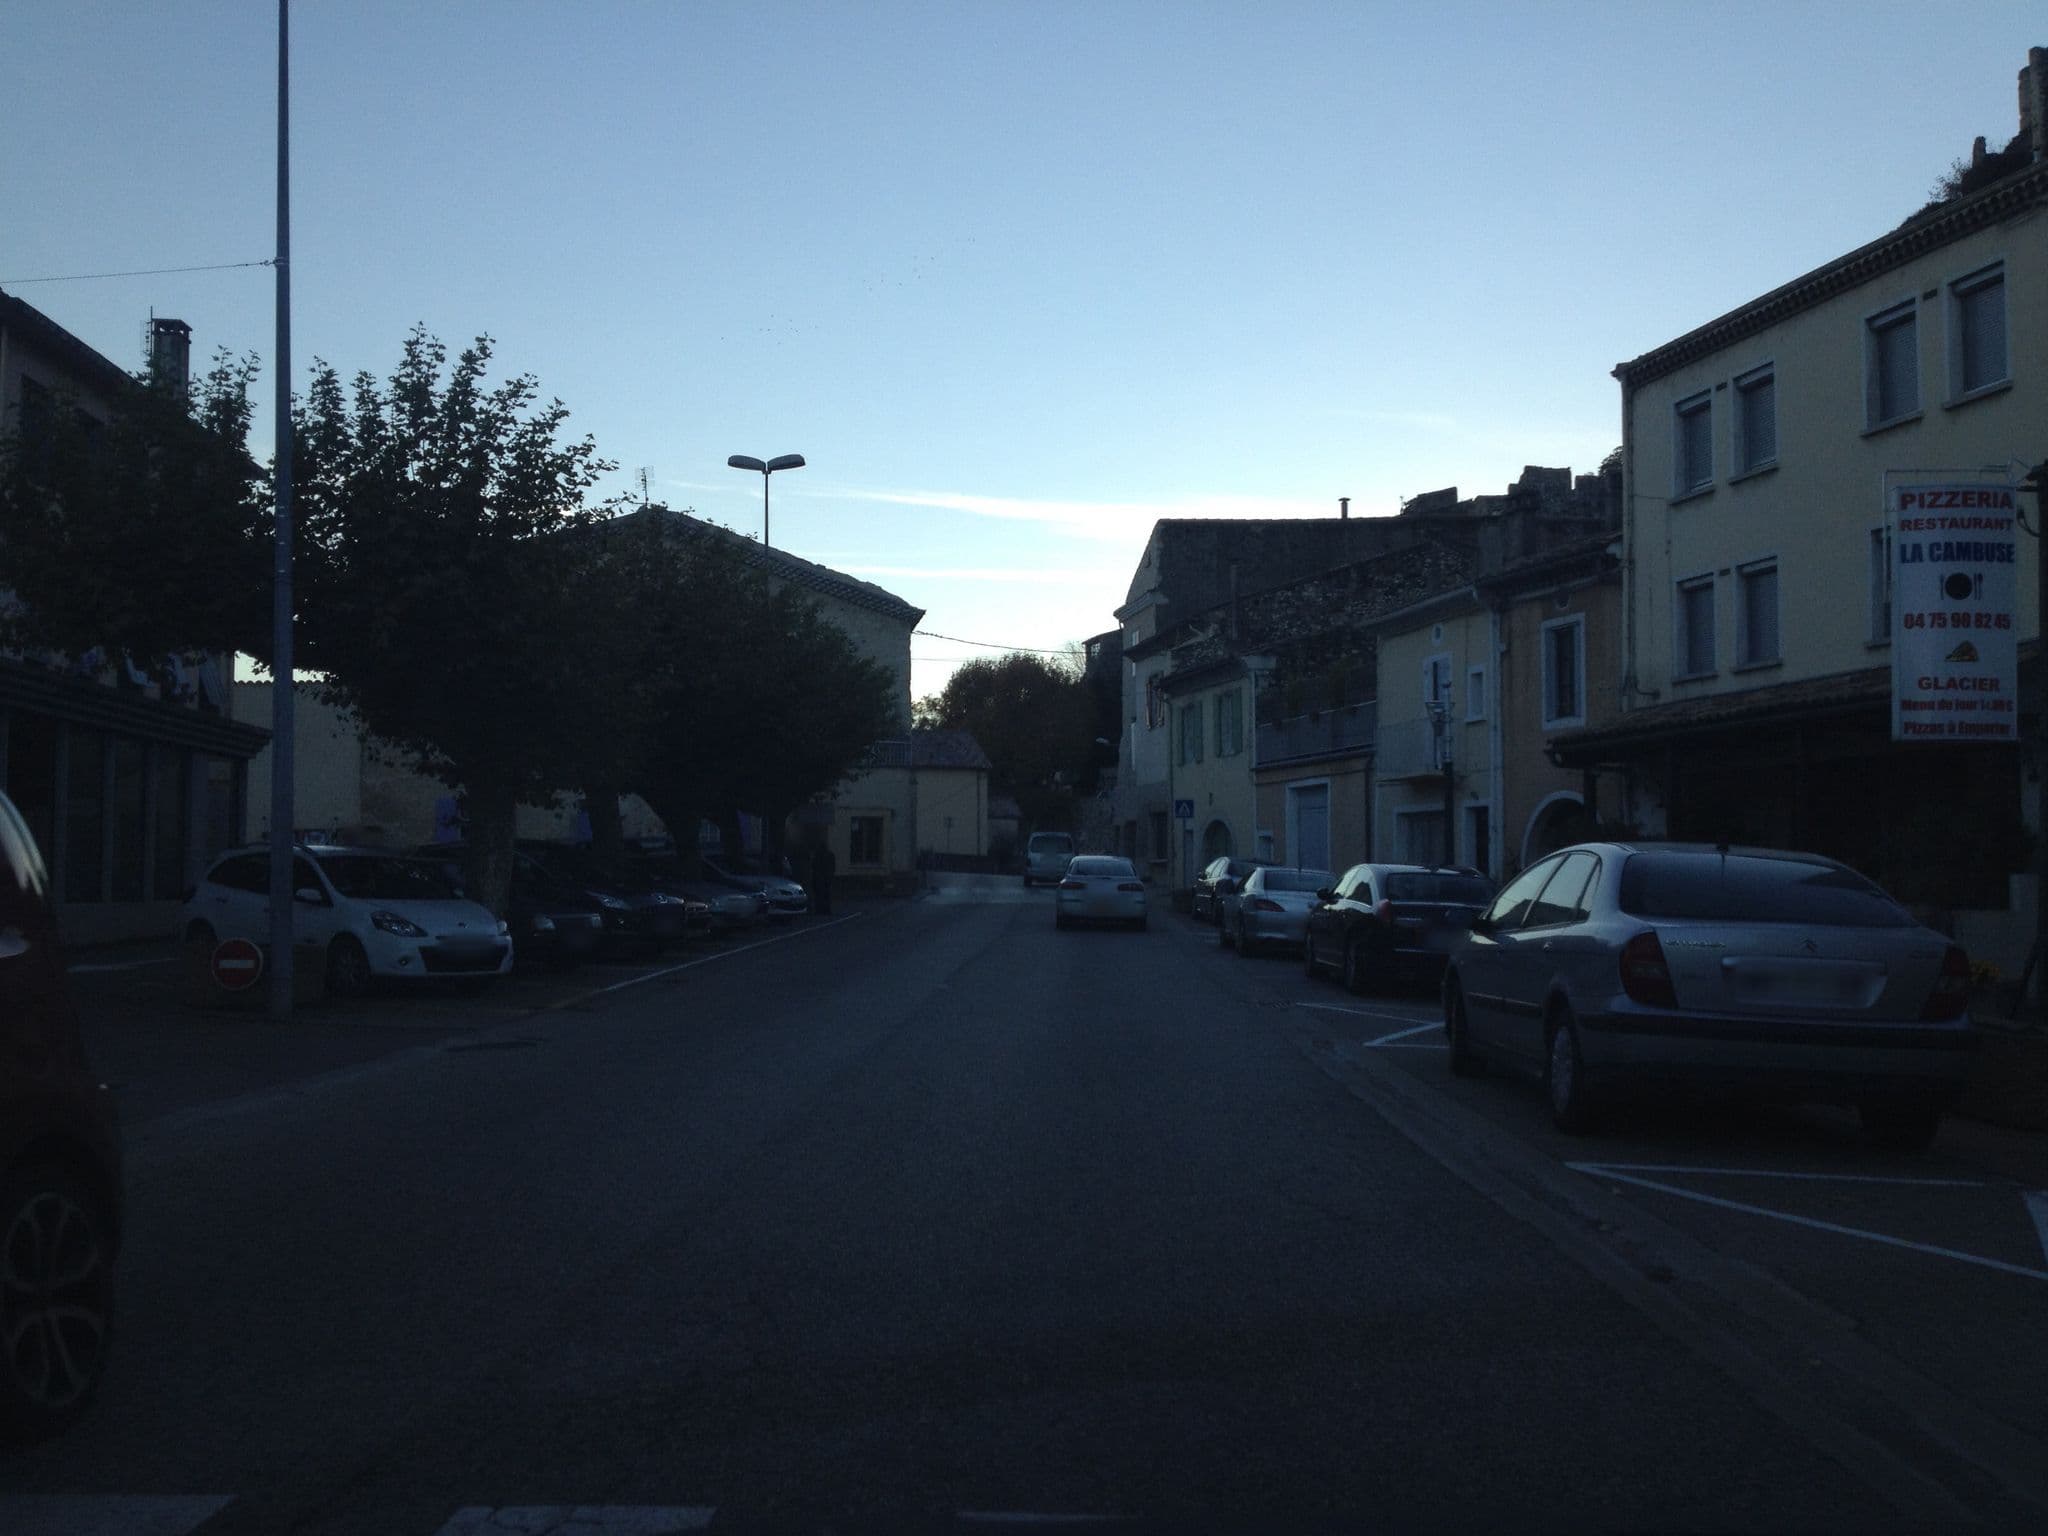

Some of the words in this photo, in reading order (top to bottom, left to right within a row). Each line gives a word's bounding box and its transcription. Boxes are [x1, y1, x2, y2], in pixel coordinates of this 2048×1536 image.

[1900, 490, 2014, 510] PIZZERIA
[1900, 517, 2014, 531] RESTAURANT
[1900, 543, 1924, 564] LA
[1929, 542, 2015, 564] CAMBUSE
[1904, 612, 1926, 630] 04
[1928, 612, 1948, 629] 75
[1918, 676, 2000, 692] GLACIER
